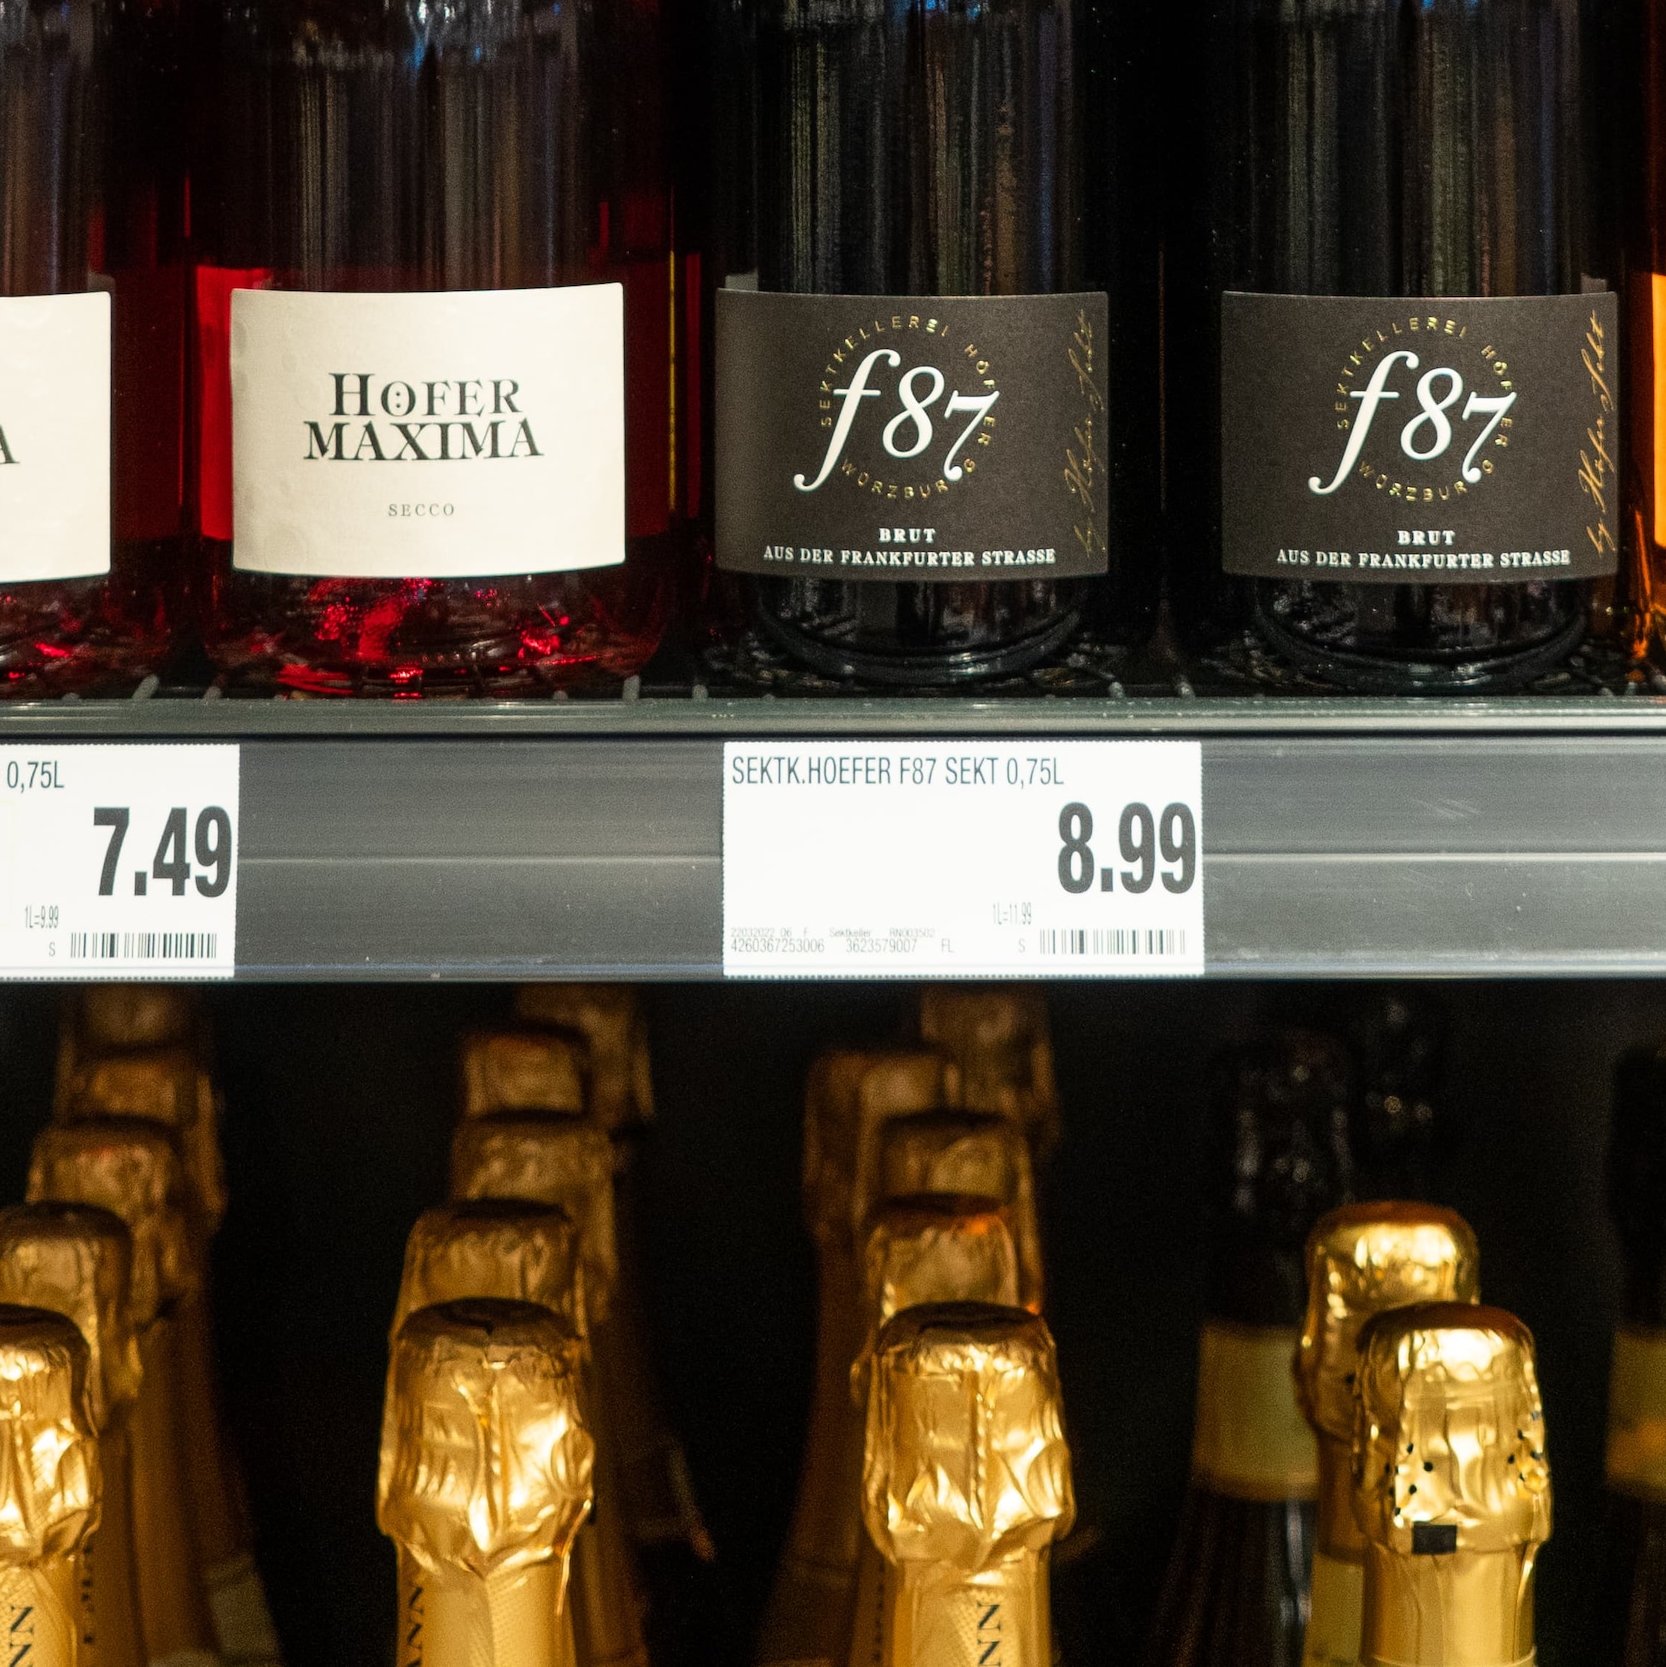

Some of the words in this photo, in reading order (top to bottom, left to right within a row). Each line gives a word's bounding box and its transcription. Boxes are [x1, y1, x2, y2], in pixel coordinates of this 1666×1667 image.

[302, 415, 545, 463] MAXIMA
[387, 501, 456, 518] SECCO
[878, 527, 936, 543] BRUT
[1396, 529, 1456, 546] BRUT
[763, 544, 795, 561] AUS
[799, 547, 833, 564] DER
[840, 549, 975, 568] FRANKFURTER
[981, 547, 1057, 567] STRASSE
[1276, 547, 1312, 567] AUS
[1315, 549, 1352, 568] DER
[1358, 551, 1495, 570] FRANKFURTER
[1499, 548, 1571, 568] STRASSE
[6, 761, 65, 794] 0,75L
[732, 756, 892, 786] SEKTK.HOEFER
[900, 756, 936, 785] F87
[945, 757, 1000, 786] SEKT
[1006, 757, 1065, 791] 0,75L
[92, 805, 233, 899] 7.49
[1057, 801, 1197, 895] 8.99
[24, 904, 60, 930] 1L=9.99
[48, 942, 56, 957] S
